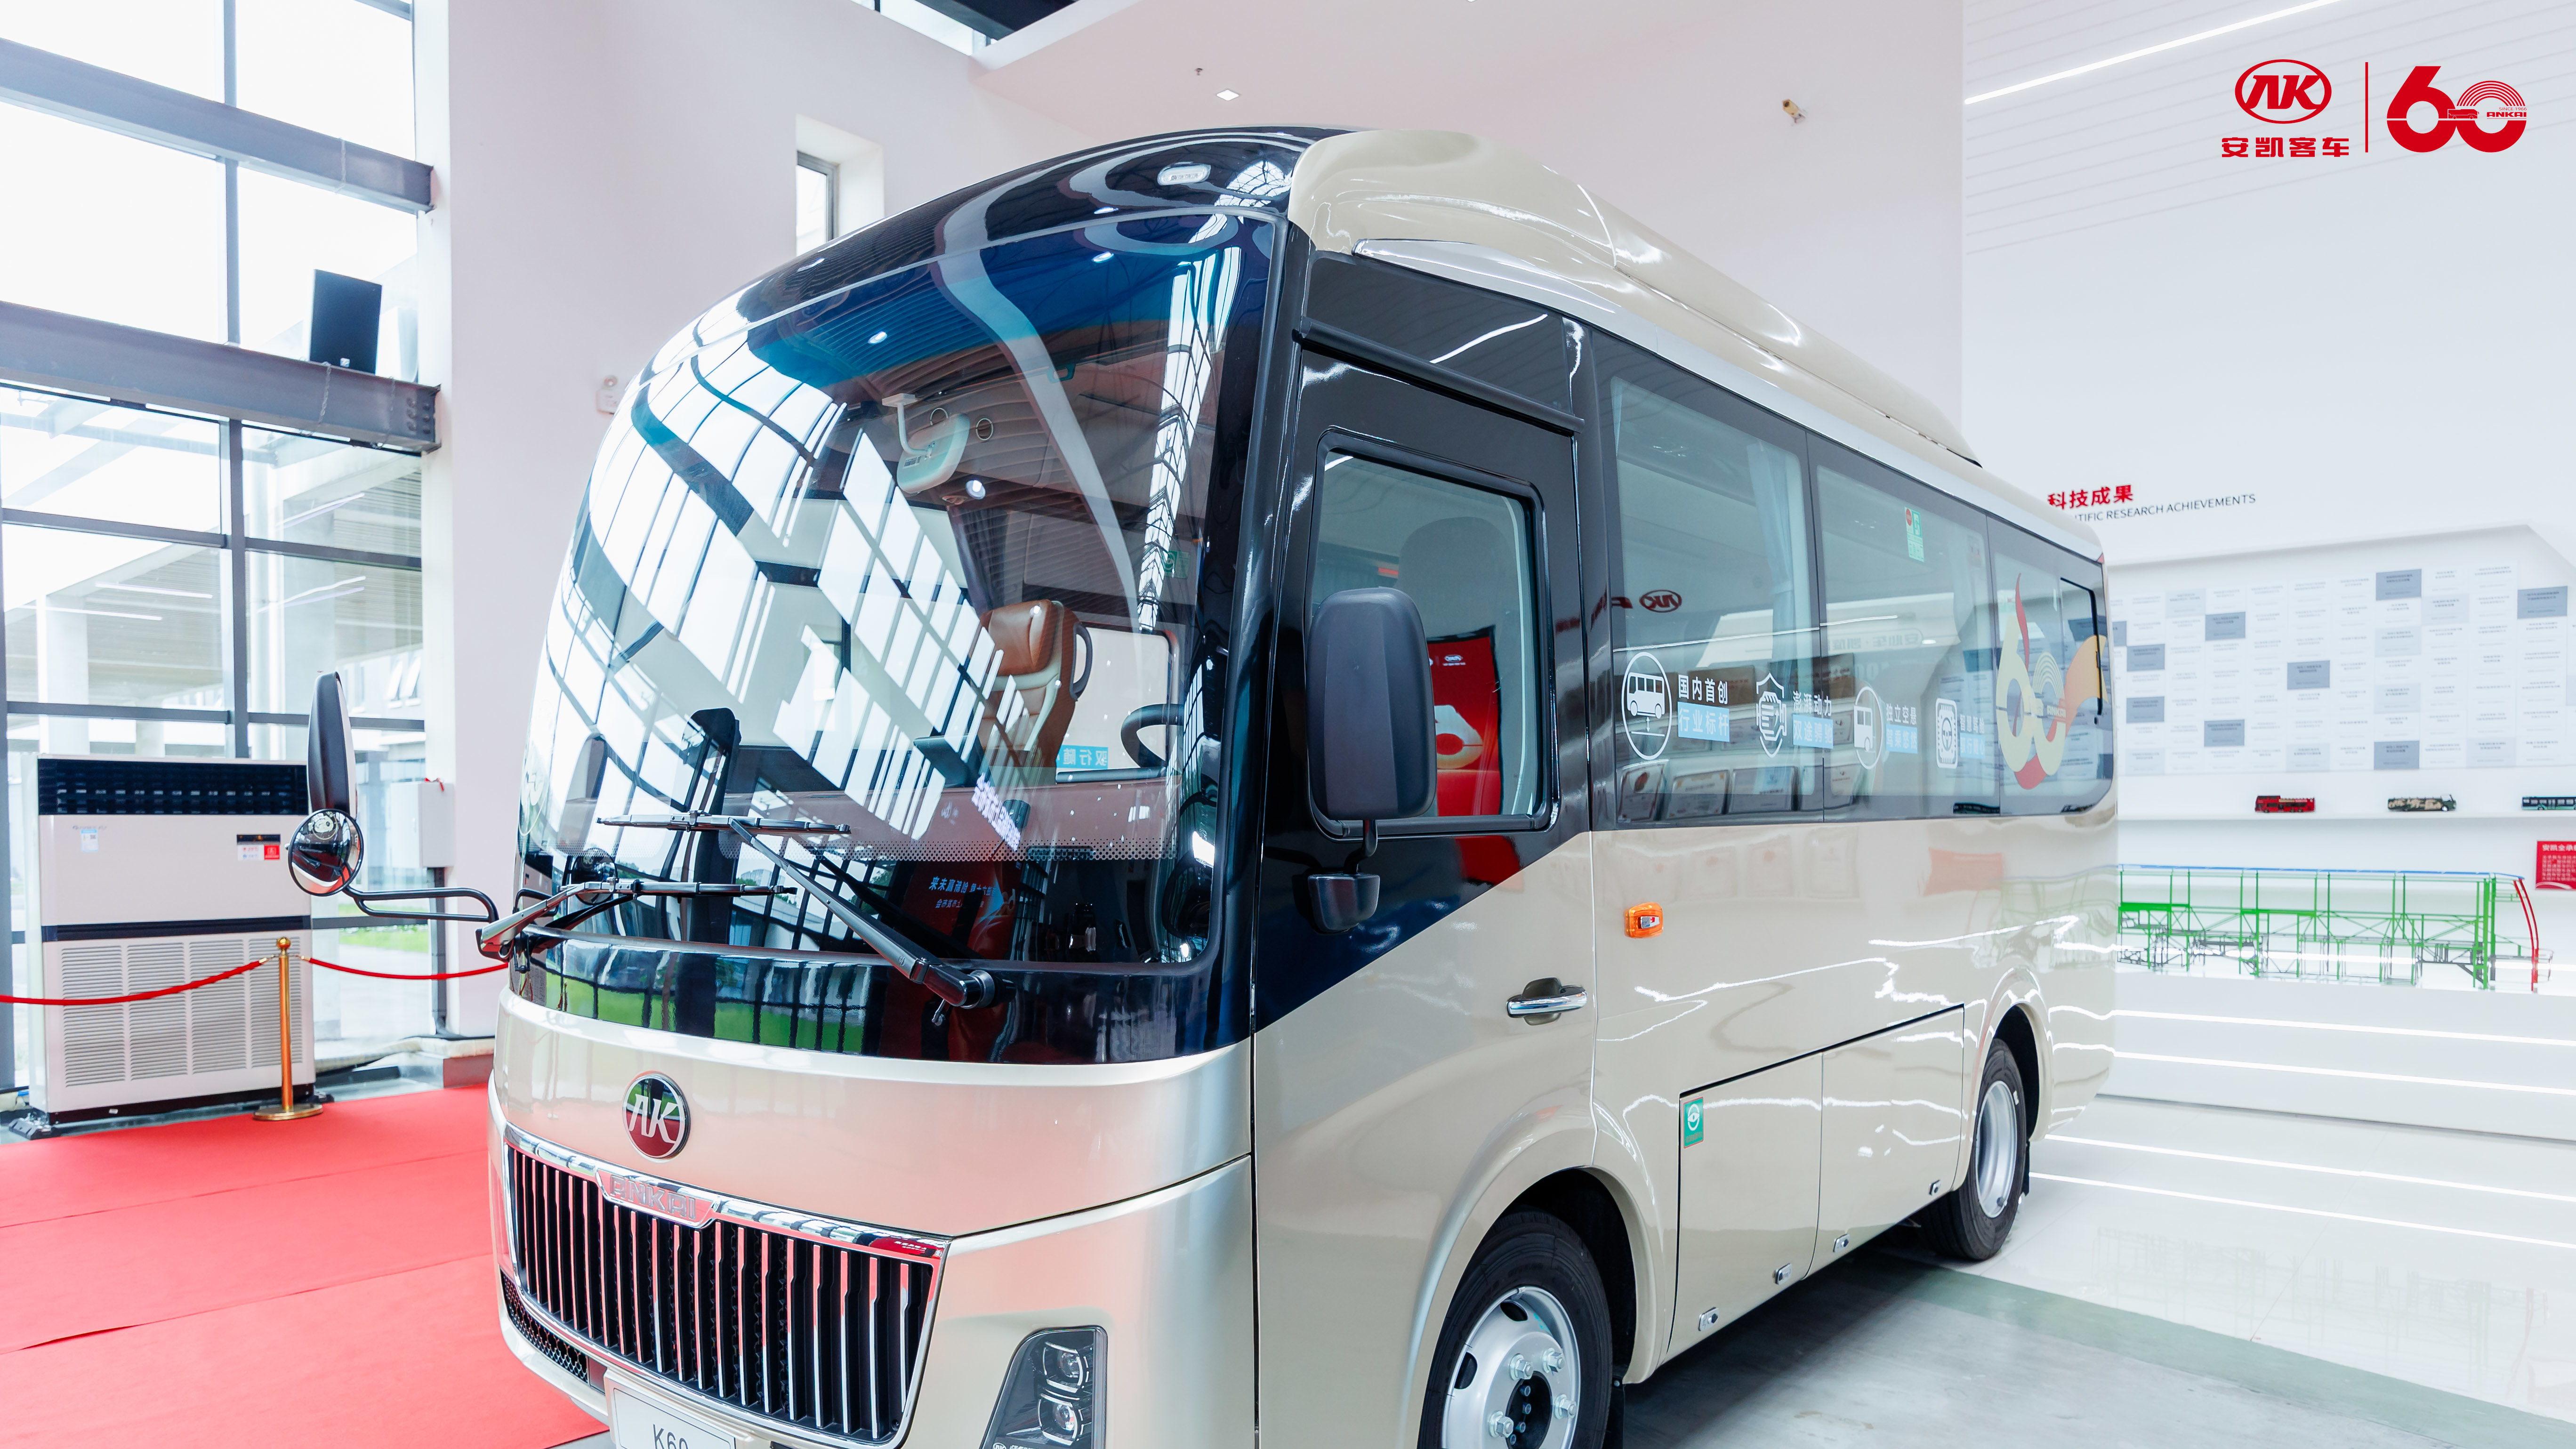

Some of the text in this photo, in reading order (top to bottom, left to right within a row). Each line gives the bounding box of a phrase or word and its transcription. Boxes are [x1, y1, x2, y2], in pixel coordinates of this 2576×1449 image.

[2048, 484, 2133, 510] 科技成果
[2106, 505, 2164, 520] RESEARCH
[2166, 493, 2256, 513] ACHIEVEMENTS
[1678, 674, 1728, 705] 国内首创
[1793, 690, 1832, 716] 澎湃动力
[1679, 708, 1729, 736] 行业标杆
[1886, 703, 1917, 725] 独立空悬
[610, 1174, 696, 1220] ANKAI
